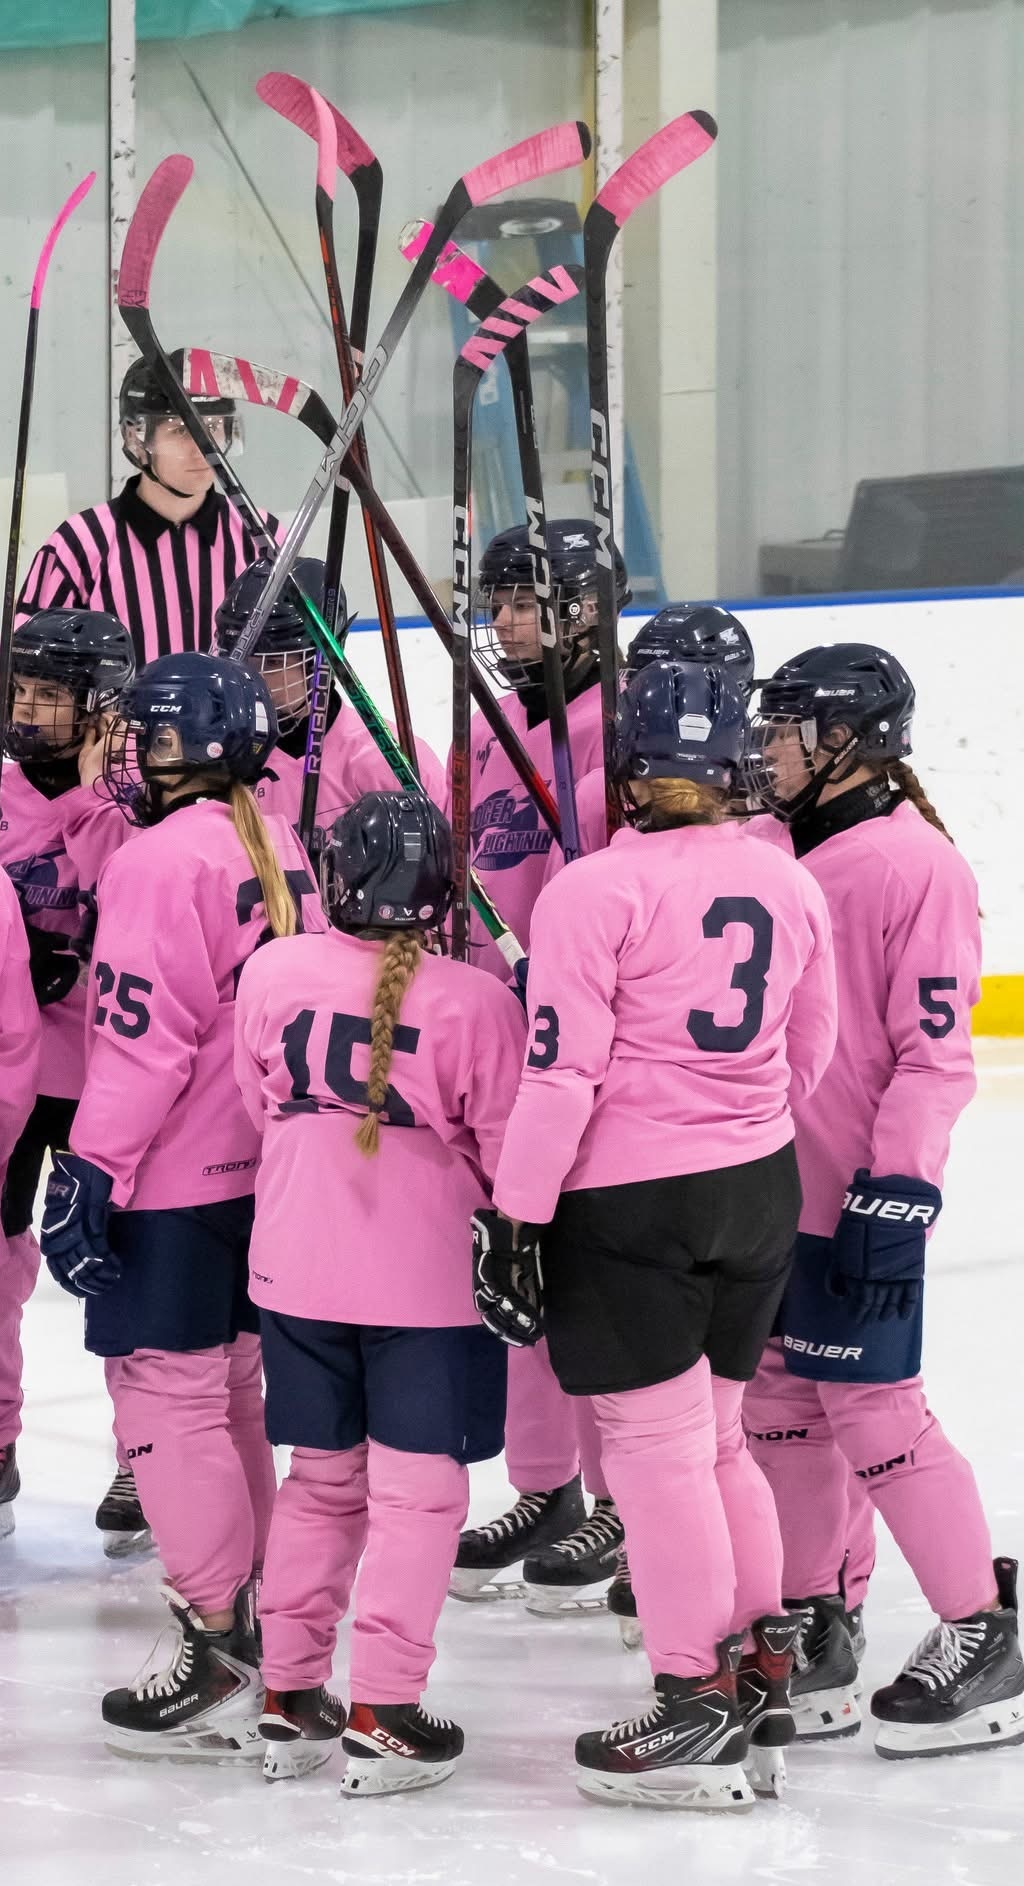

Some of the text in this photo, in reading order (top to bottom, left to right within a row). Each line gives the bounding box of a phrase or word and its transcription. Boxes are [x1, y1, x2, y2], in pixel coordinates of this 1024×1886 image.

[314, 344, 389, 492] CCM
[591, 409, 613, 570] CCM
[453, 505, 469, 638] CCM
[526, 495, 557, 648] CCM
[151, 705, 182, 714] CCM
[483, 830, 552, 855] LIGHTNIN
[686, 896, 774, 1052] 3
[95, 961, 153, 1040] 25
[918, 976, 957, 1039] 5
[527, 1004, 560, 1070] 3
[280, 1008, 421, 1127] 15
[842, 1191, 935, 1226] AUER
[784, 1335, 862, 1361] BAUER
[764, 1624, 799, 1635] CCM
[160, 1693, 199, 1718] BAUER
[319, 1711, 337, 1727] CCM
[371, 1727, 415, 1757] CCM
[634, 1731, 675, 1757] CCM
